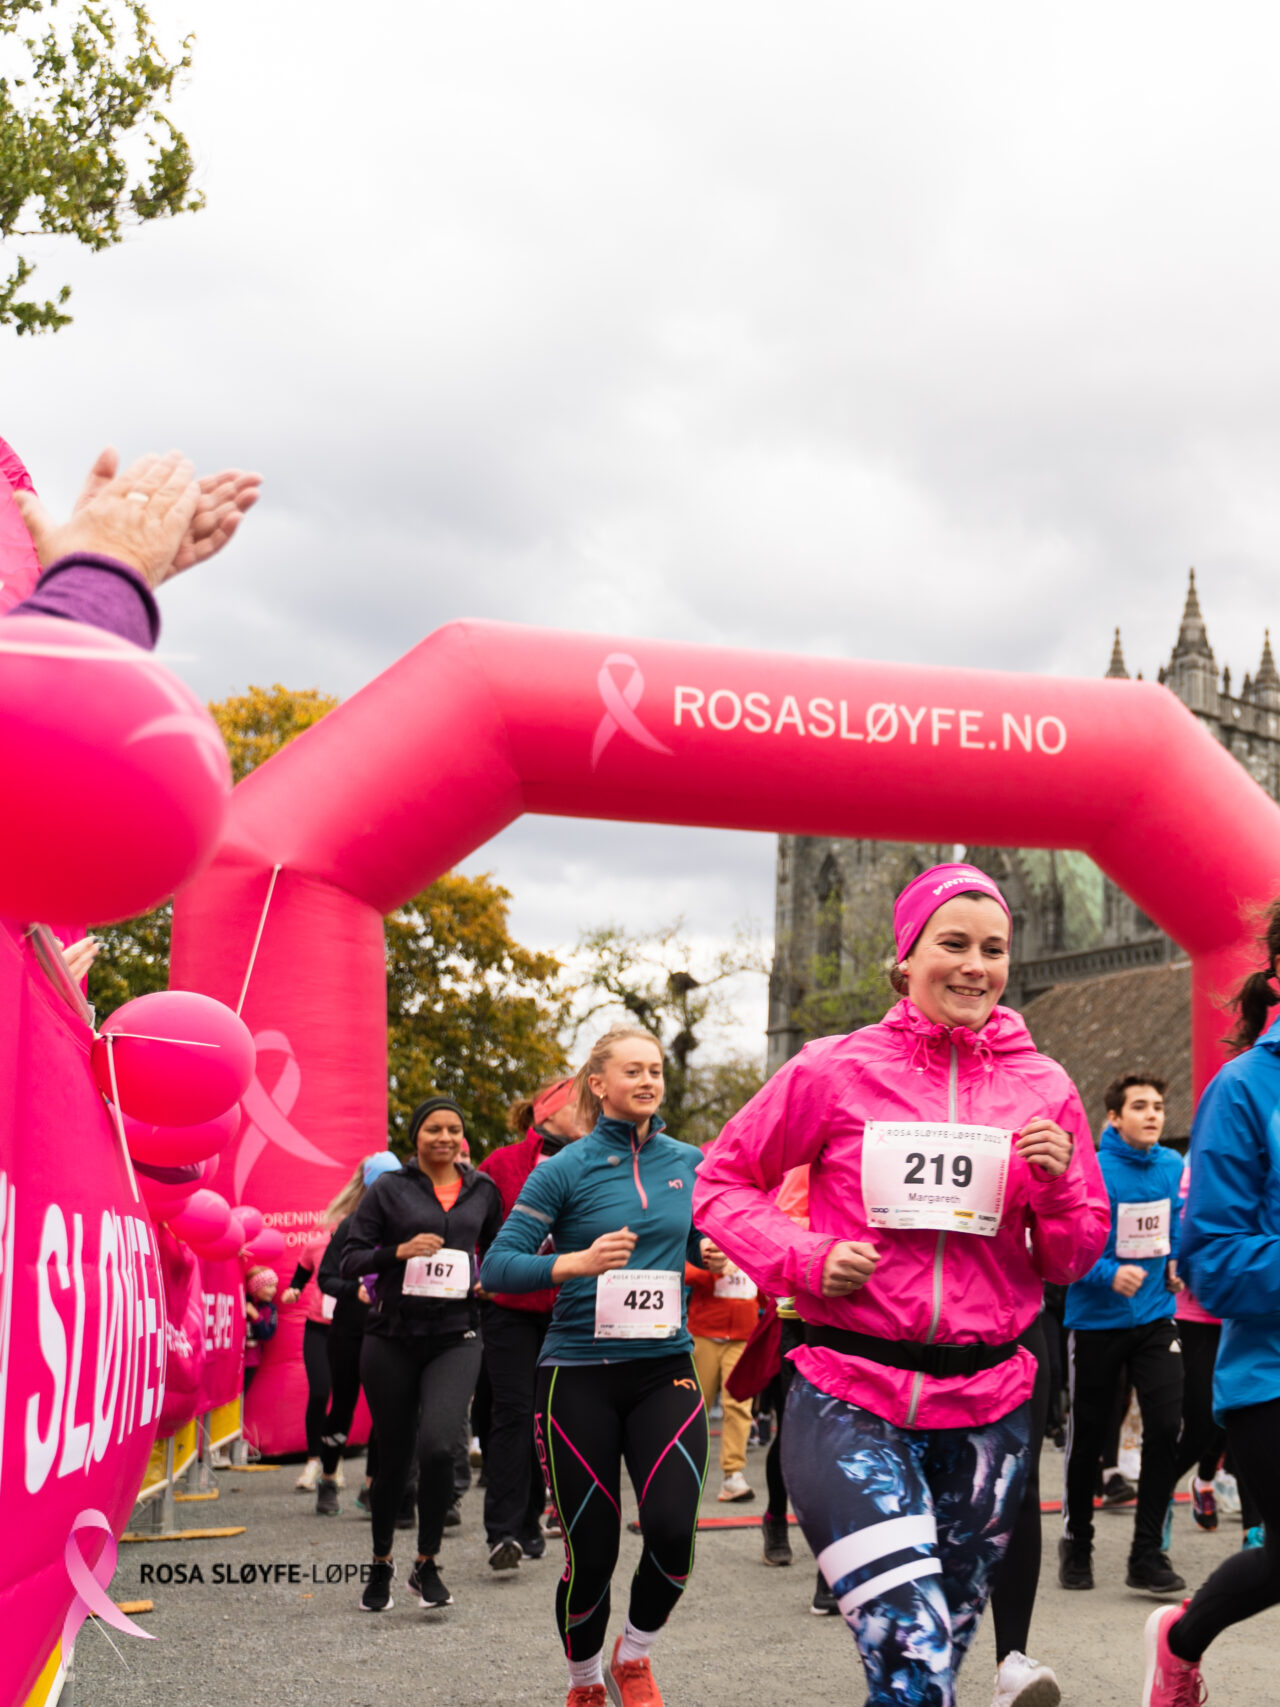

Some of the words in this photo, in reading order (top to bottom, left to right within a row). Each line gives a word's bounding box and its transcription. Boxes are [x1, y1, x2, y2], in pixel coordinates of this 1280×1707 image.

[673, 686, 1067, 755] ROSASLØYFE.NO
[904, 1152, 972, 1188] 219
[908, 1192, 961, 1204] Margareth
[1136, 1216, 1160, 1231] 102
[425, 1262, 454, 1277] 167
[624, 1290, 664, 1310] 423
